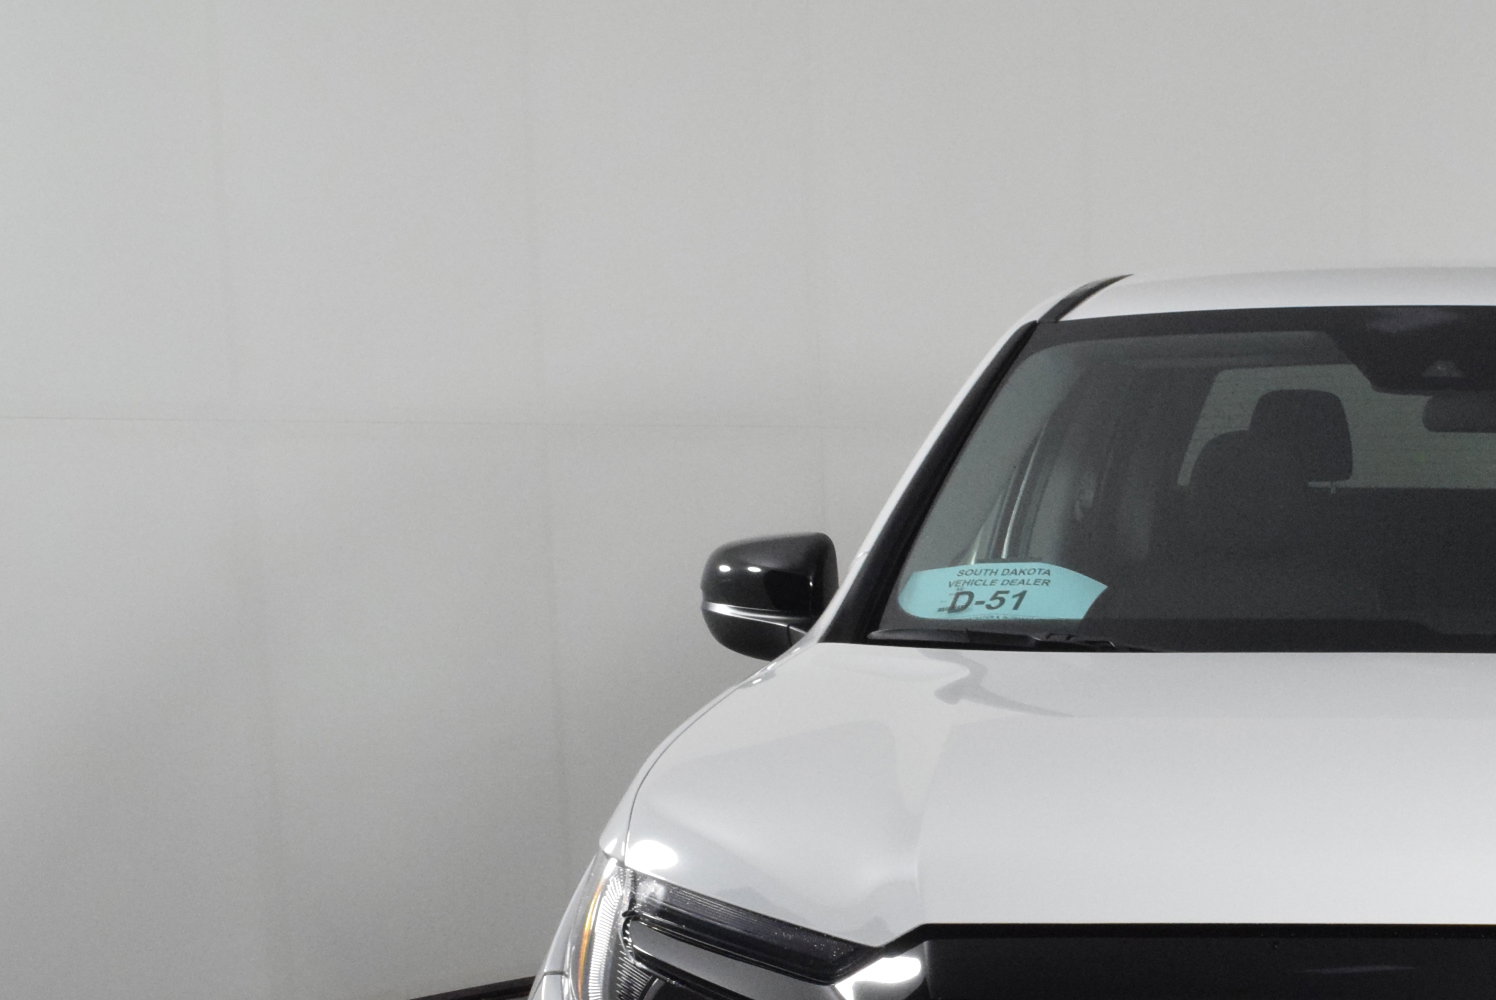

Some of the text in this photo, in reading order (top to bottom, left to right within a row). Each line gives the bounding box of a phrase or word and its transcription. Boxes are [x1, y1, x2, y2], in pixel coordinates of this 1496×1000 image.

[957, 568, 1051, 577] SOUTH DAKOTA
[949, 578, 1051, 588] VEHICLE DEALER
[947, 590, 1028, 614] D-51
